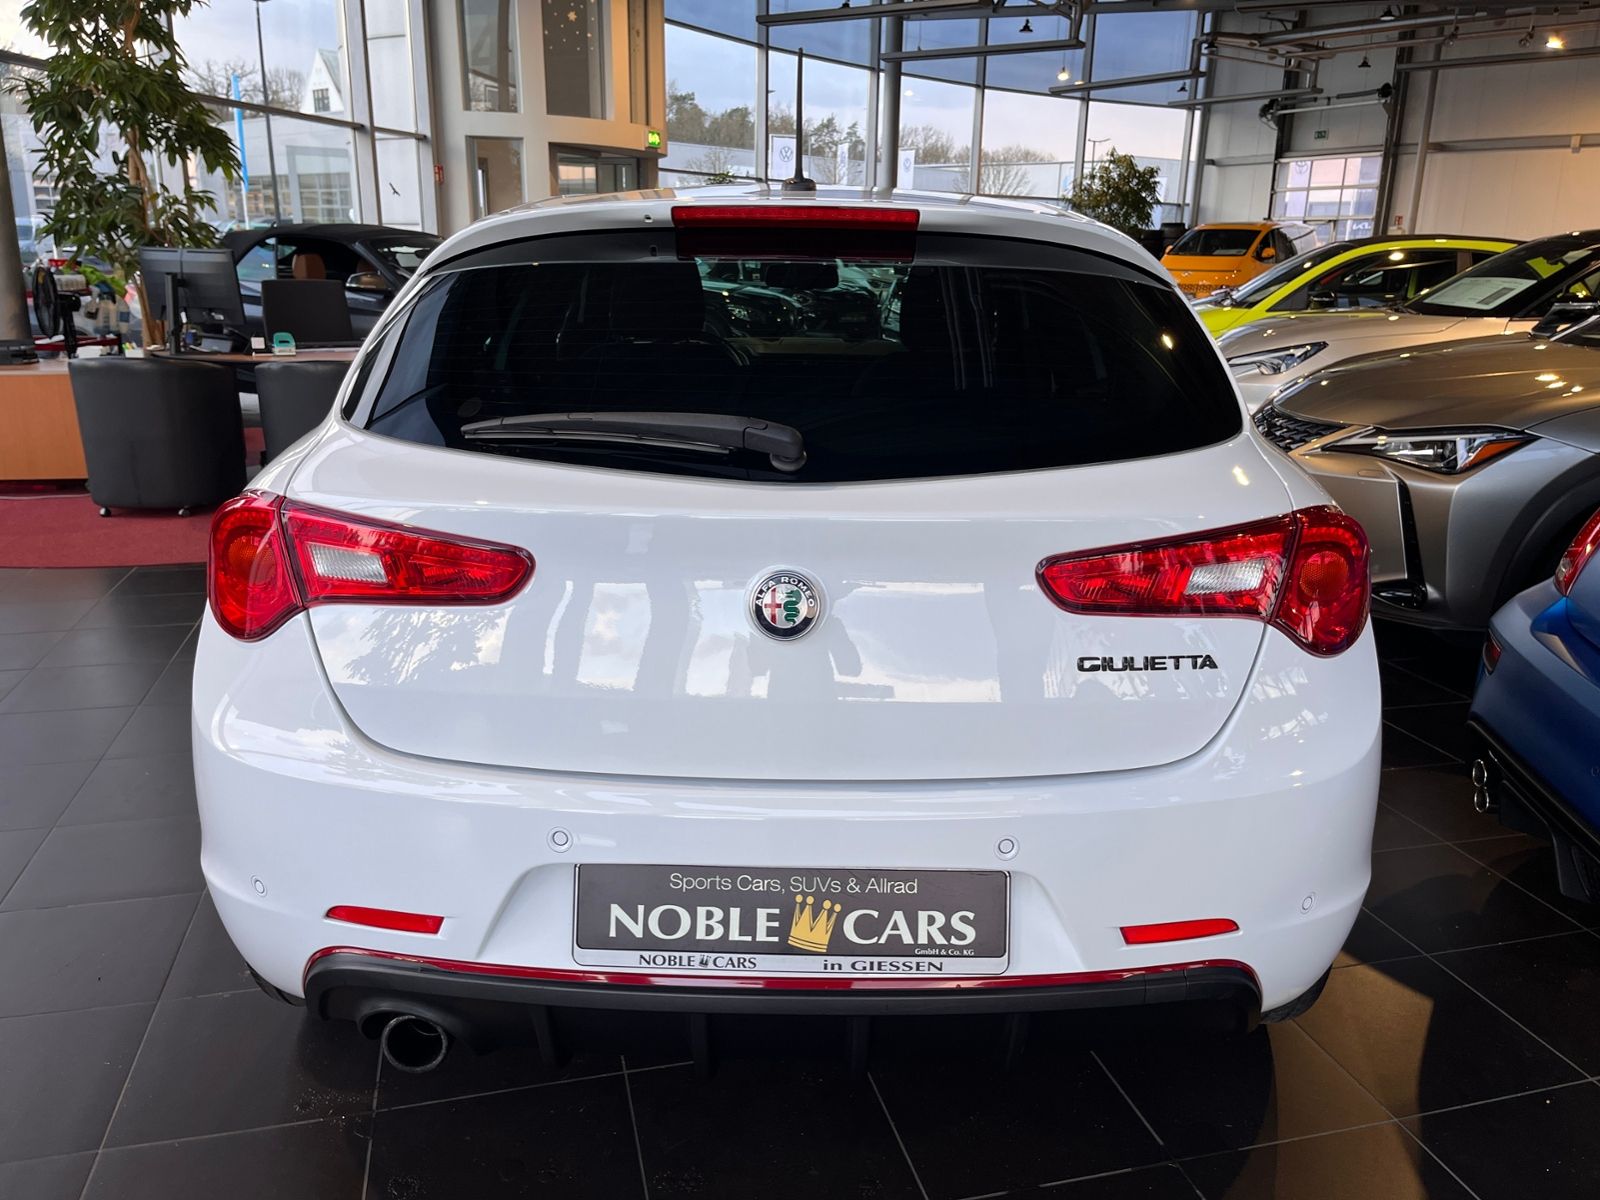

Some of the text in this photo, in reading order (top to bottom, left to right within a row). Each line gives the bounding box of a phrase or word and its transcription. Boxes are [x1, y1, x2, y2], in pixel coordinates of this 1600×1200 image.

[755, 576, 815, 607] ALFA ROMEO
[1077, 654, 1219, 672] GIULIETTA
[669, 872, 918, 894] Sports Cars, SUVs & Allrad
[609, 903, 977, 946] NOBLE CARS
[639, 954, 757, 969] NOBLE CARS
[823, 959, 944, 972] in GIESSEN
